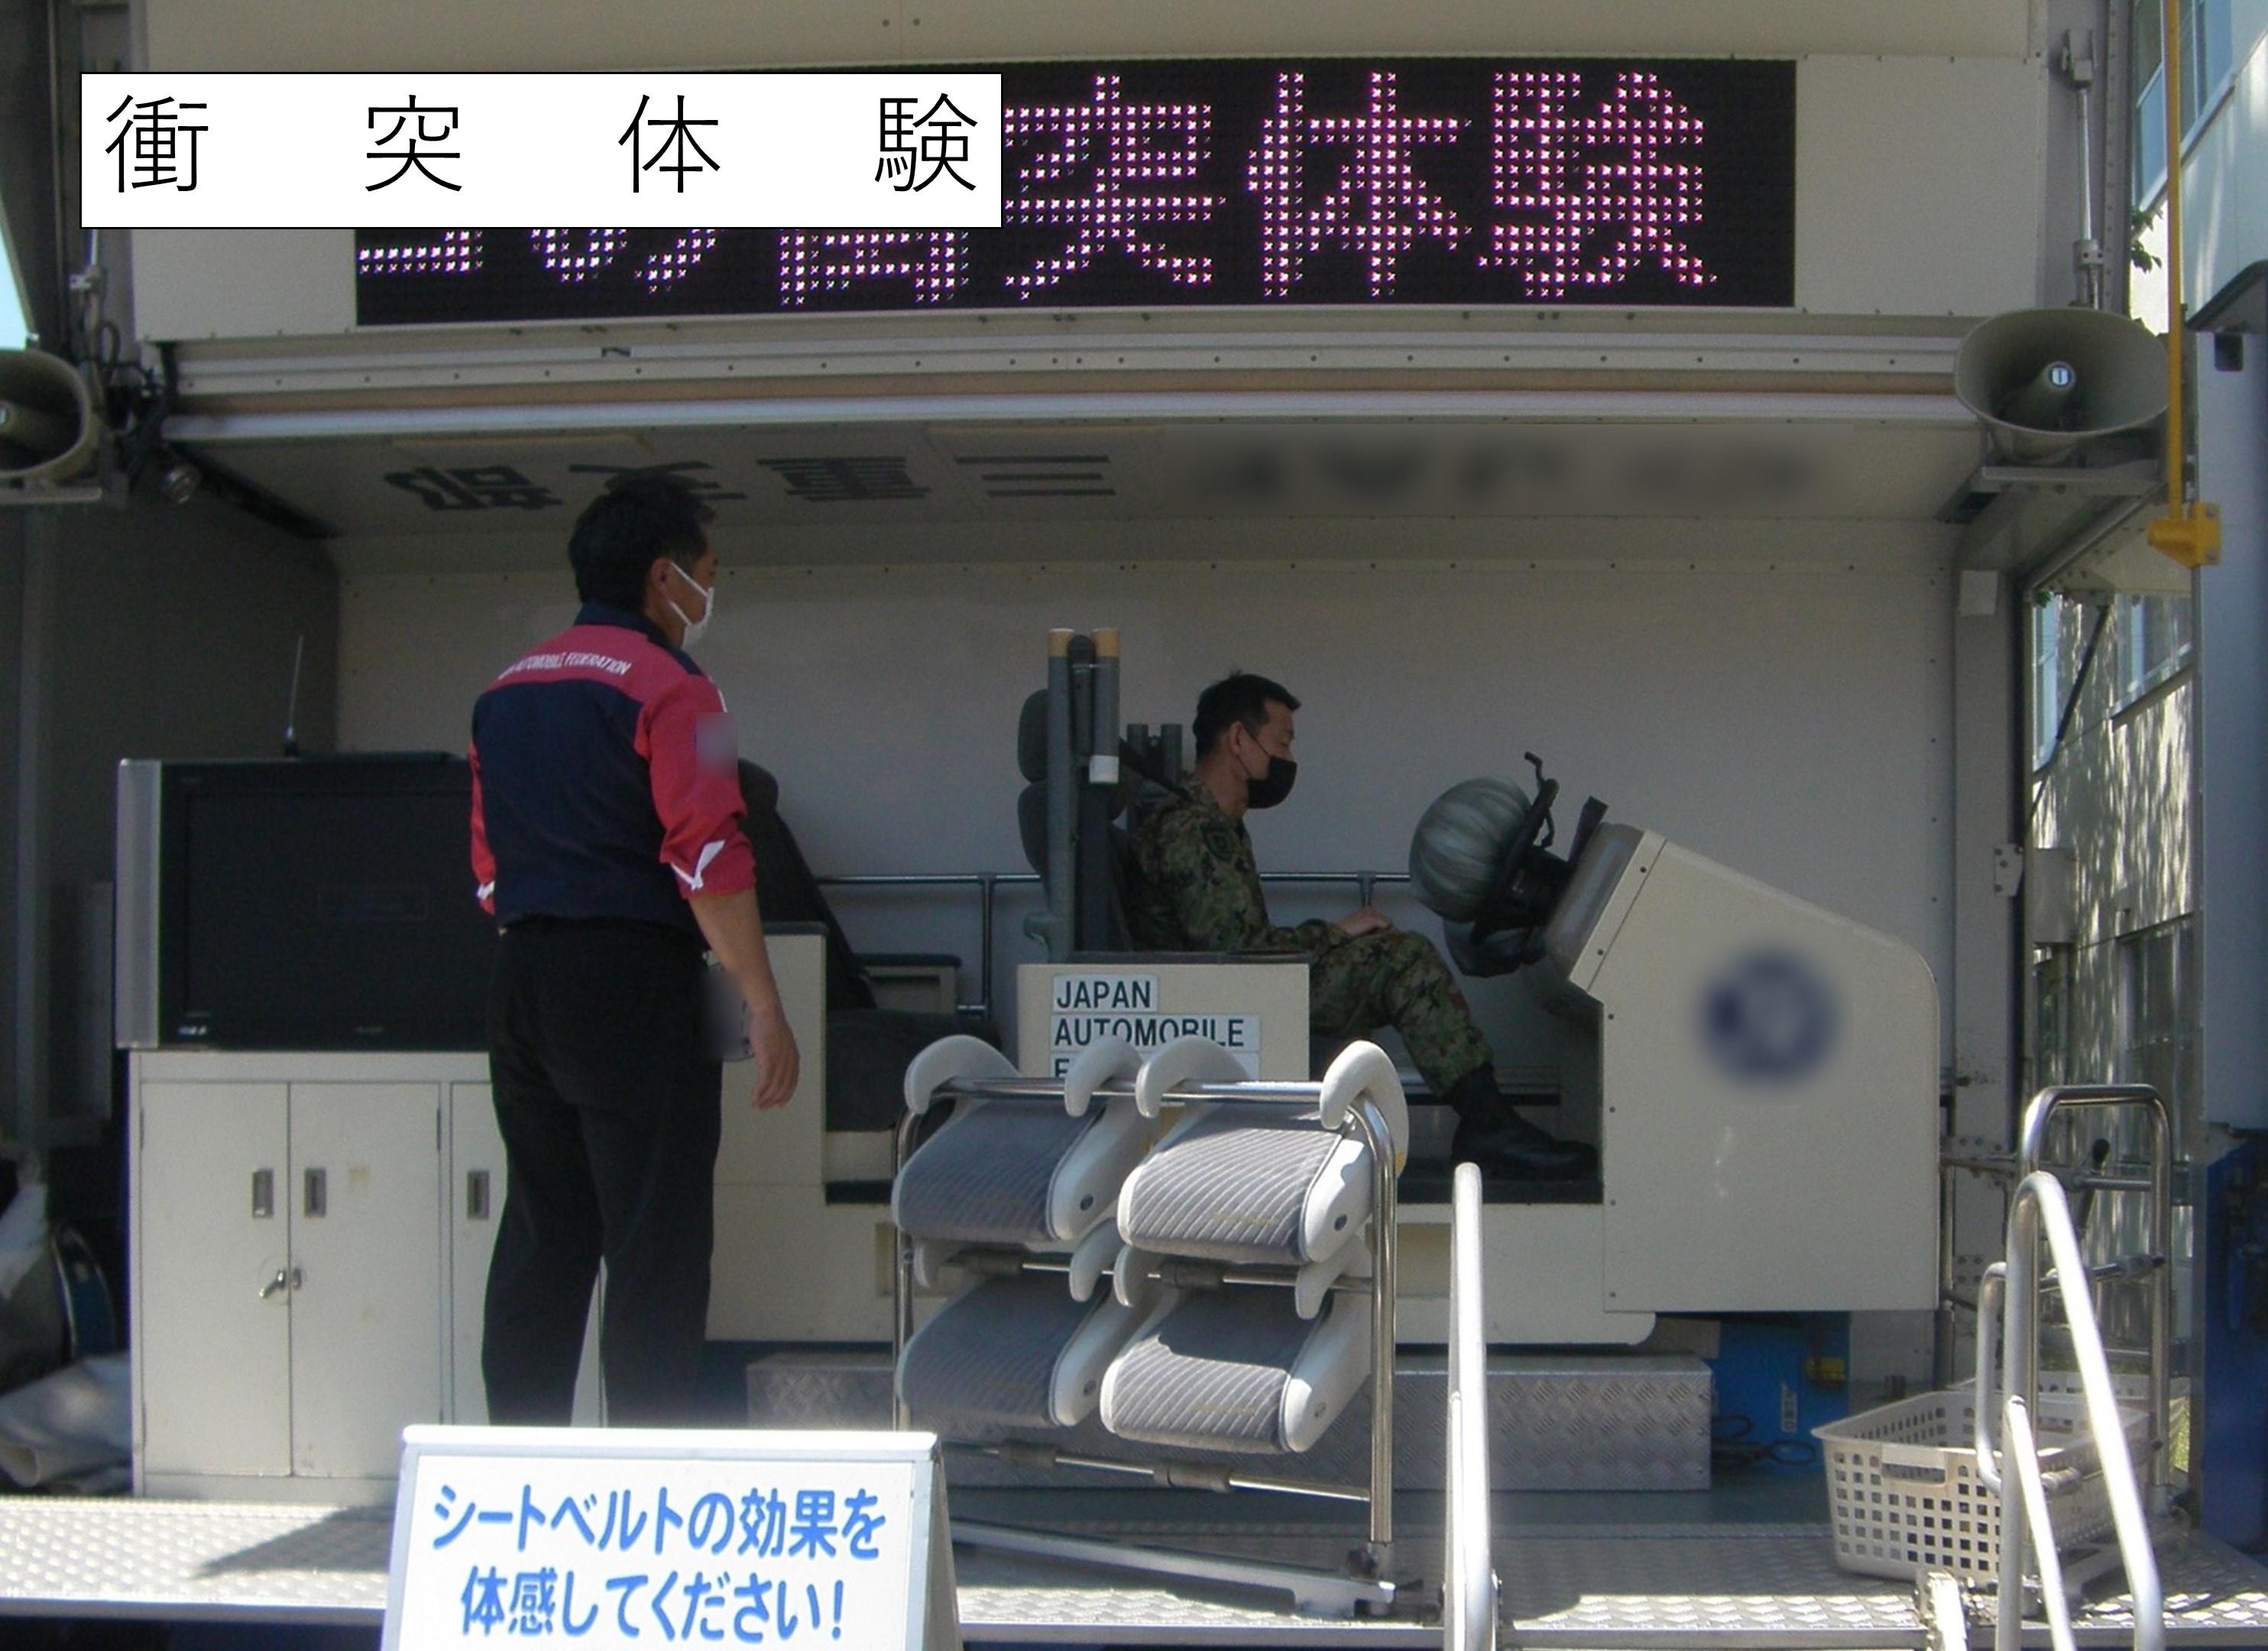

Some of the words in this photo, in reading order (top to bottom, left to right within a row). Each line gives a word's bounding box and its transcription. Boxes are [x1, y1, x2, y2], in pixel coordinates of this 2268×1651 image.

[1057, 981, 1151, 1008] JAPAN
[433, 1484, 886, 1561] シートベルトの効果を
[460, 1565, 844, 1643] 体感してください!
